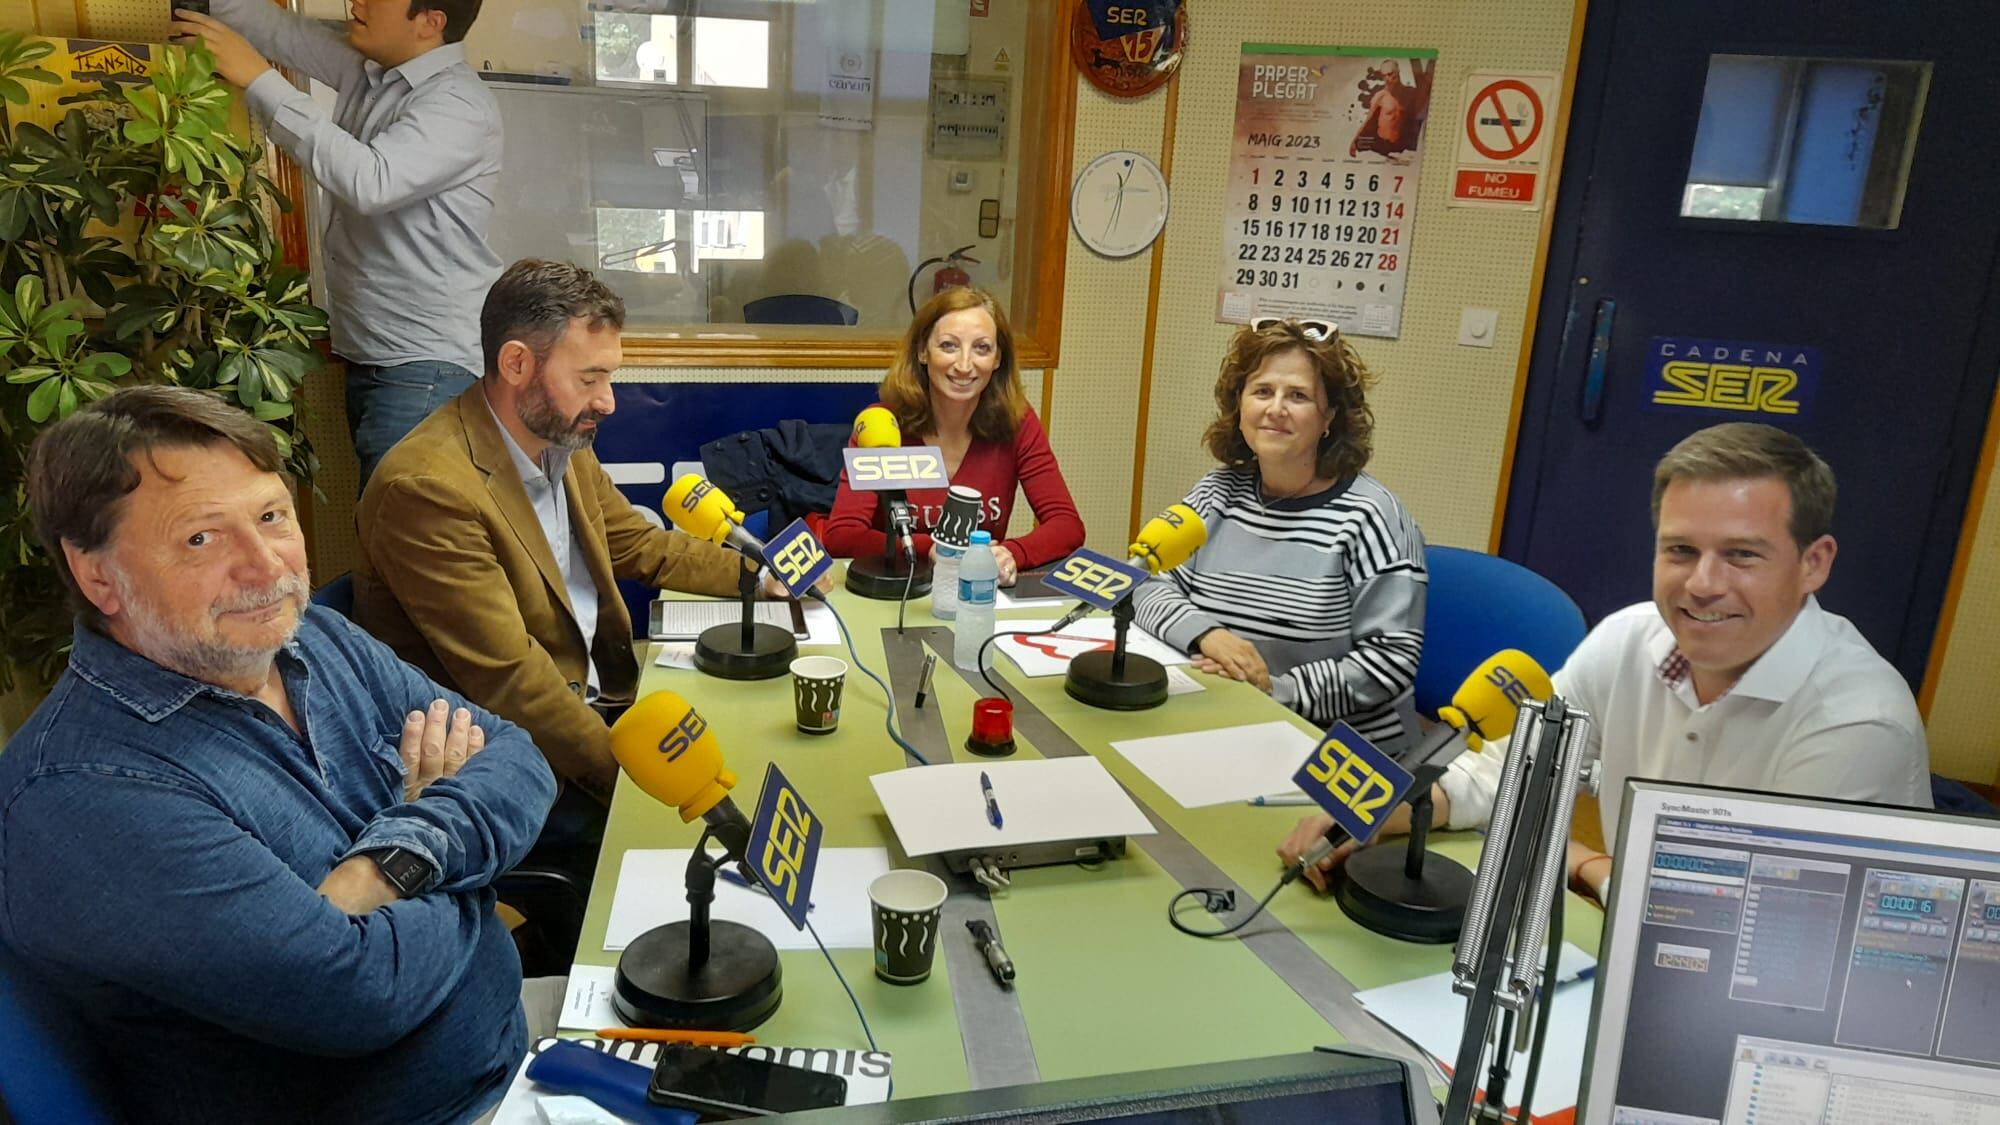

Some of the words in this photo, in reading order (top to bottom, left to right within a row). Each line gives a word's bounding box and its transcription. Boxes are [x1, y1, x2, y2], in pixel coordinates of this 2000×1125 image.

[1106, 6, 1147, 26] SER
[1254, 65, 1308, 82] PAPER
[1253, 81, 1318, 99] PLEGAT
[1247, 133, 1282, 147] MAIG
[1285, 134, 1321, 149] 2023
[1251, 168, 1260, 185] 1
[1274, 169, 1284, 186] 2
[1297, 171, 1308, 188] 3
[1321, 172, 1331, 189] 4
[1344, 173, 1355, 190] 5
[1368, 175, 1379, 192] 6
[1393, 176, 1404, 193] 7
[1484, 172, 1508, 184] NO
[1468, 185, 1520, 199] FUMEU
[1248, 194, 1259, 211] 8
[1271, 195, 1282, 212] 9
[1291, 196, 1309, 214] 10
[1314, 198, 1331, 215] 11
[1338, 199, 1356, 217] 12
[1362, 201, 1380, 218] 13
[1386, 202, 1404, 219] 14
[1242, 219, 1260, 236] 15
[1265, 220, 1283, 237] 16
[1288, 222, 1306, 239] 17
[1311, 223, 1330, 241] 18
[1335, 225, 1353, 242] 19
[1357, 226, 1377, 244] 20
[1381, 228, 1399, 245] 21
[1238, 243, 1257, 260] 22
[1261, 245, 1280, 262] 23
[1284, 247, 1303, 264] 24
[1307, 248, 1326, 266] 25
[1330, 250, 1350, 267] 26
[1354, 252, 1374, 269] 27
[1377, 254, 1398, 271] 28
[1236, 268, 1255, 285] 29
[1258, 270, 1278, 287] 30
[1281, 272, 1299, 289] 31
[1660, 343, 1809, 366] CADENA
[1652, 360, 1801, 415] SER
[852, 454, 942, 481] SER
[773, 531, 826, 587] SER
[1053, 556, 1133, 601] SER
[1485, 665, 1534, 706] SE
[658, 707, 707, 764] SE
[1306, 738, 1395, 826] SER
[762, 787, 811, 907] SER
